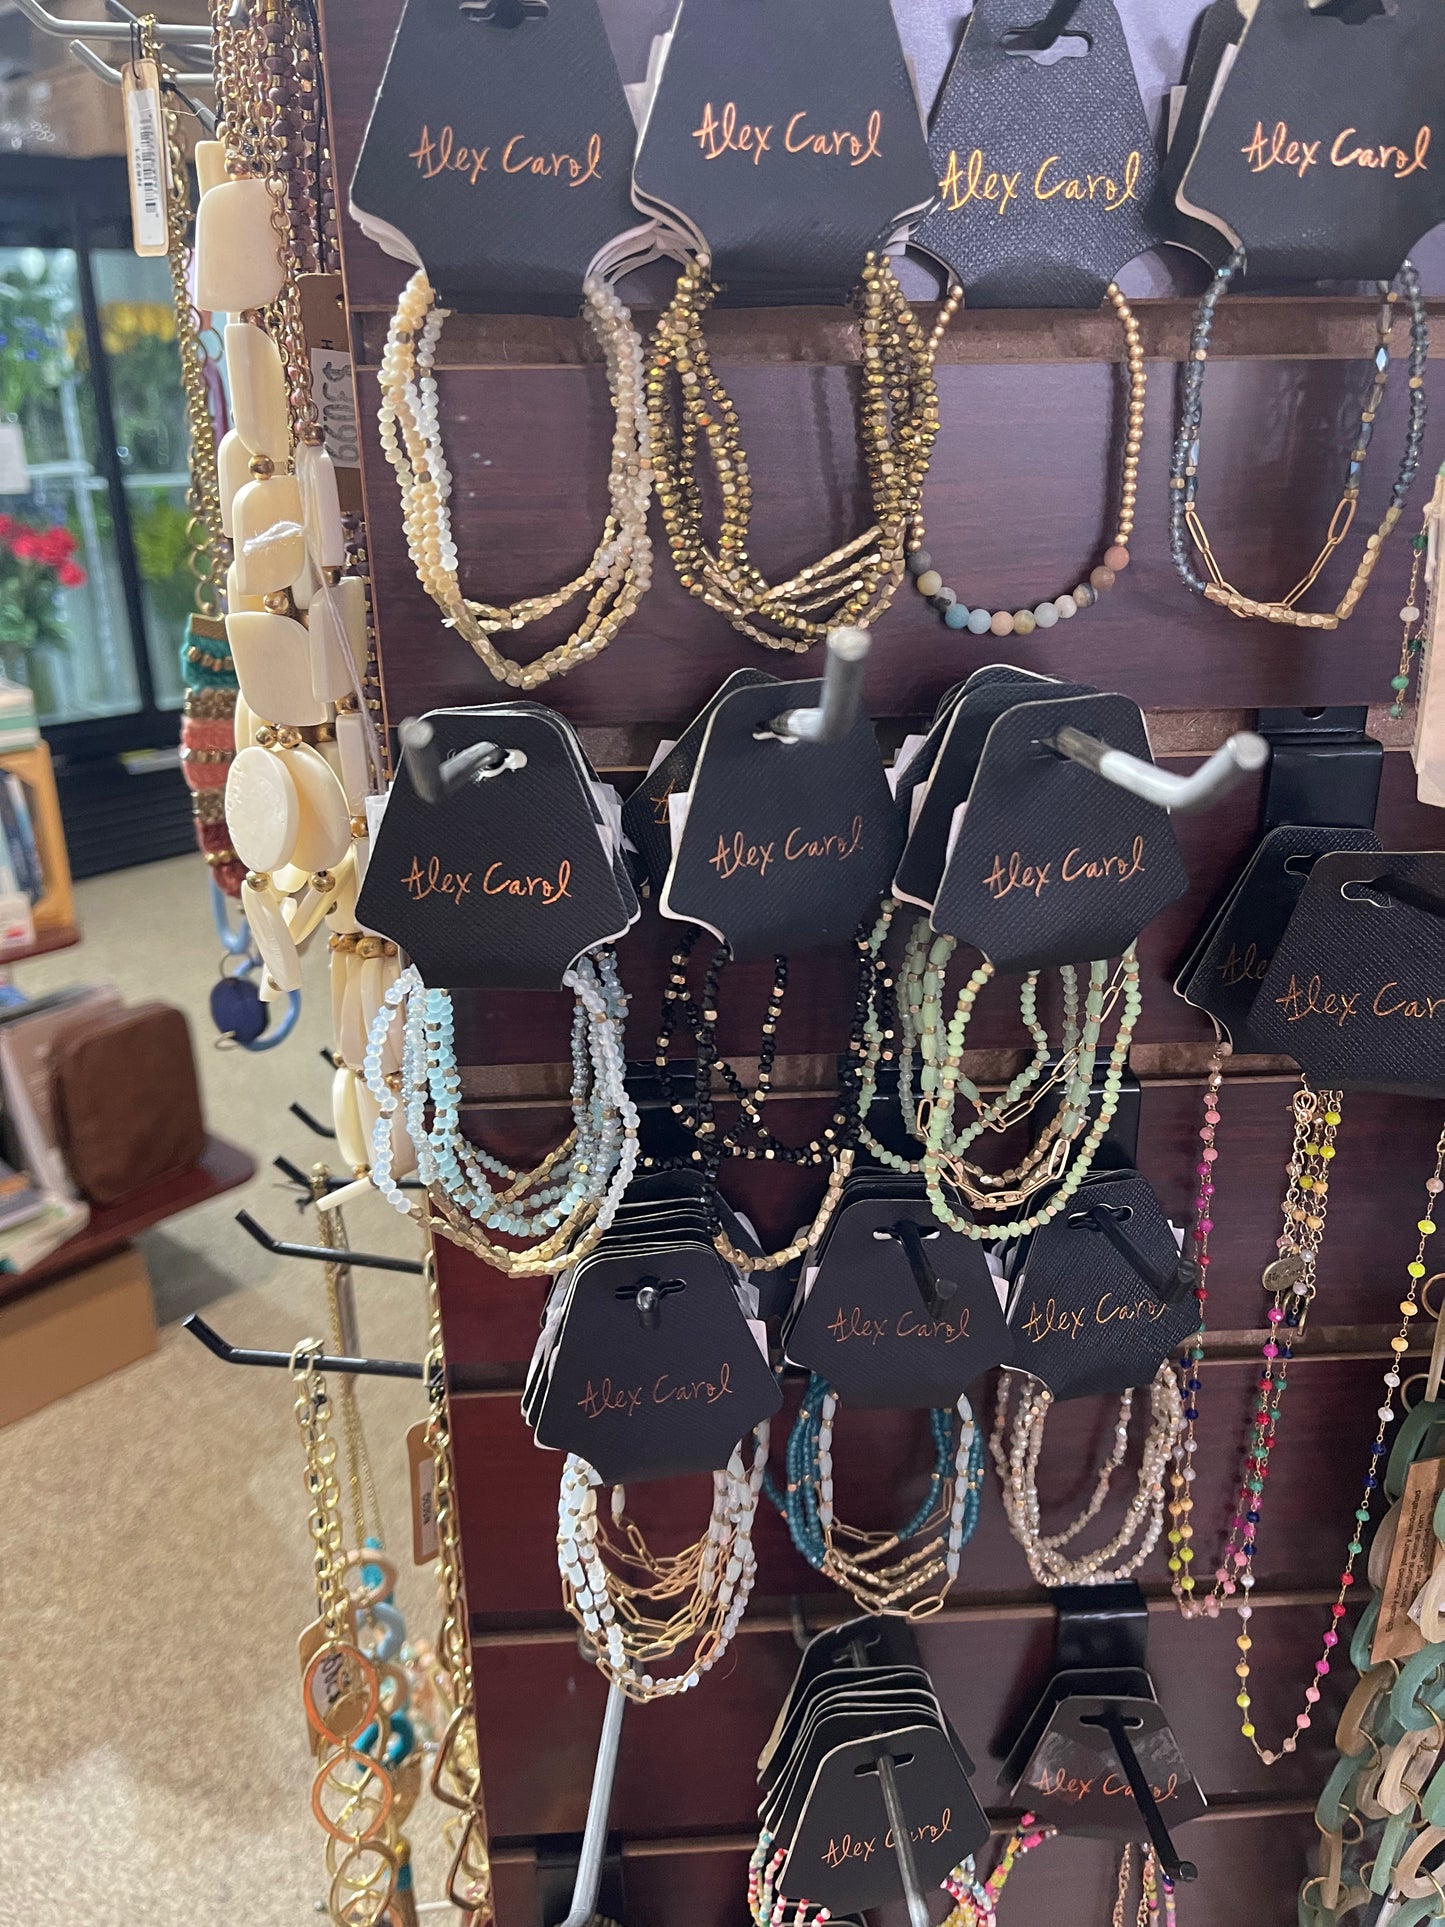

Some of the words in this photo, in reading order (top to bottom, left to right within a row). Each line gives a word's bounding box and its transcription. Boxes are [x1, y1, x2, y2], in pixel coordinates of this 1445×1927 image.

[409, 125, 491, 185] Alex
[502, 134, 602, 187] Carol
[692, 102, 773, 165] Alex
[784, 110, 882, 166] Carol
[1241, 121, 1321, 178] Alex
[1330, 126, 1432, 179] Carol
[938, 150, 1021, 215] Alex
[1034, 151, 1141, 212] Carol
[709, 831, 774, 879] Alex
[784, 816, 864, 862] Carol
[982, 851, 1051, 899] Alex
[1061, 835, 1146, 883] Carol
[401, 856, 471, 905] Alex
[482, 860, 573, 905] Carol
[1217, 943, 1271, 987] Ale
[1275, 974, 1361, 1027] Alex
[1373, 981, 1445, 1019] Car
[827, 1306, 887, 1345] Alex
[897, 1307, 970, 1342] Carol
[1021, 1298, 1086, 1343] Alex
[577, 1377, 643, 1419] Alex
[652, 1362, 733, 1404] Carol
[1031, 1768, 1094, 1800] Alex
[821, 1834, 877, 1869] Alex
